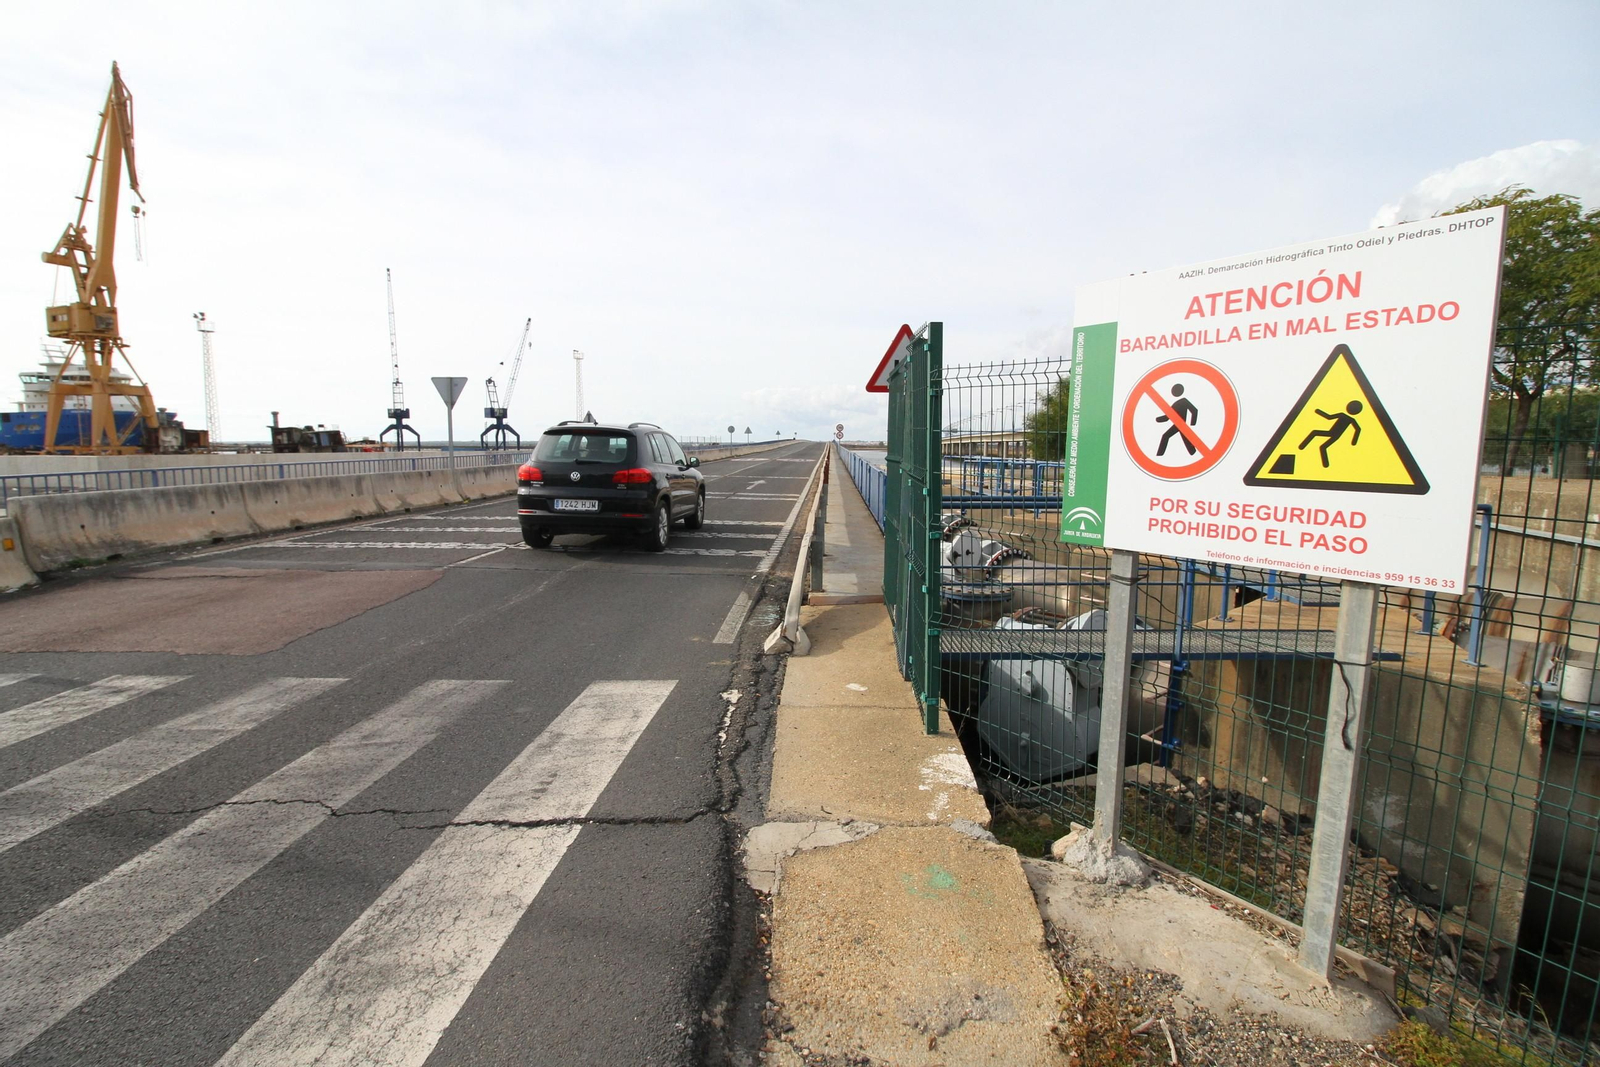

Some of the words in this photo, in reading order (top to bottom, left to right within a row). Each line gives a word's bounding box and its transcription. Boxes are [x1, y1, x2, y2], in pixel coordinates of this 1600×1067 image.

[1179, 269, 1205, 279] AAZIH.
[1208, 258, 1263, 275] Demarcación
[1266, 248, 1324, 264] Hidrográfica
[1327, 242, 1353, 254] Tinto
[1356, 236, 1385, 249] Odiel
[1388, 236, 1395, 246] y
[1397, 227, 1444, 242] Piedras.
[1448, 216, 1495, 232] DHTOP
[1184, 268, 1362, 320] ATENCIÓN
[1120, 326, 1242, 353] BARANDILLA
[1248, 322, 1278, 340] EN
[1285, 316, 1337, 336] MAL
[1345, 301, 1460, 330] ESTADO
[1076, 332, 1084, 363] TERRITORIO
[1073, 375, 1082, 409] ORDENACIÓN
[1068, 466, 1076, 497] CONSEJERÍA
[560, 500, 578, 508] 1242
[1149, 497, 1188, 514] POR
[1194, 500, 1221, 516] SU
[1227, 502, 1367, 529] SEGURIDAD
[1148, 518, 1258, 543] PROHIBIDO
[1264, 528, 1292, 546] EL
[1299, 532, 1368, 554] PASO
[1206, 550, 1241, 561] Teléfono
[1256, 558, 1310, 570] información
[1322, 565, 1381, 580] incidencias
[1384, 572, 1404, 582] 959
[1408, 576, 1421, 584] 15
[1424, 578, 1438, 586] 36
[1442, 580, 1456, 588] 33
